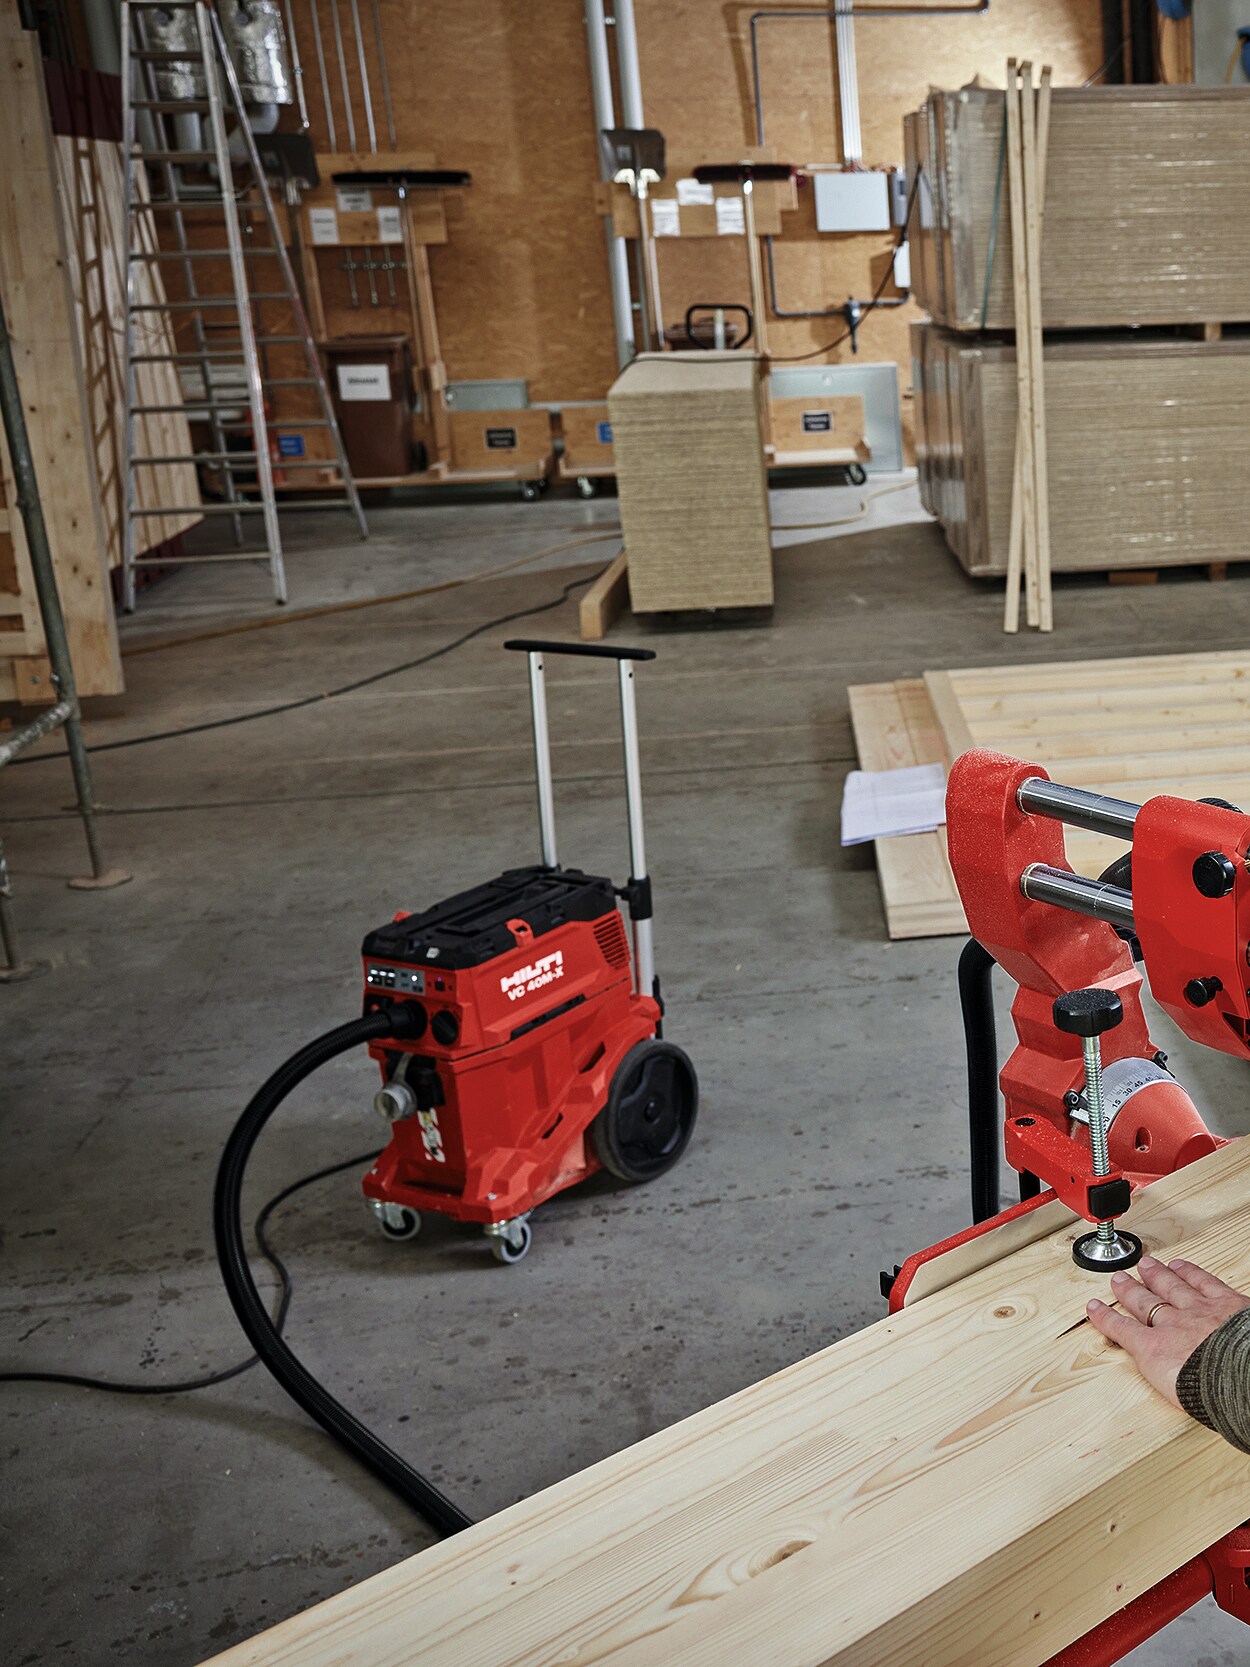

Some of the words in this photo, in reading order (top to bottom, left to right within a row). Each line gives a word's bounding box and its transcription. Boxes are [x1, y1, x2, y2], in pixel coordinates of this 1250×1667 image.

[500, 949, 563, 993] HILTI
[507, 985, 526, 1001] VC
[527, 965, 564, 991] 40M-X
[1112, 1099, 1121, 1108] 15
[1122, 1087, 1133, 1096] 30
